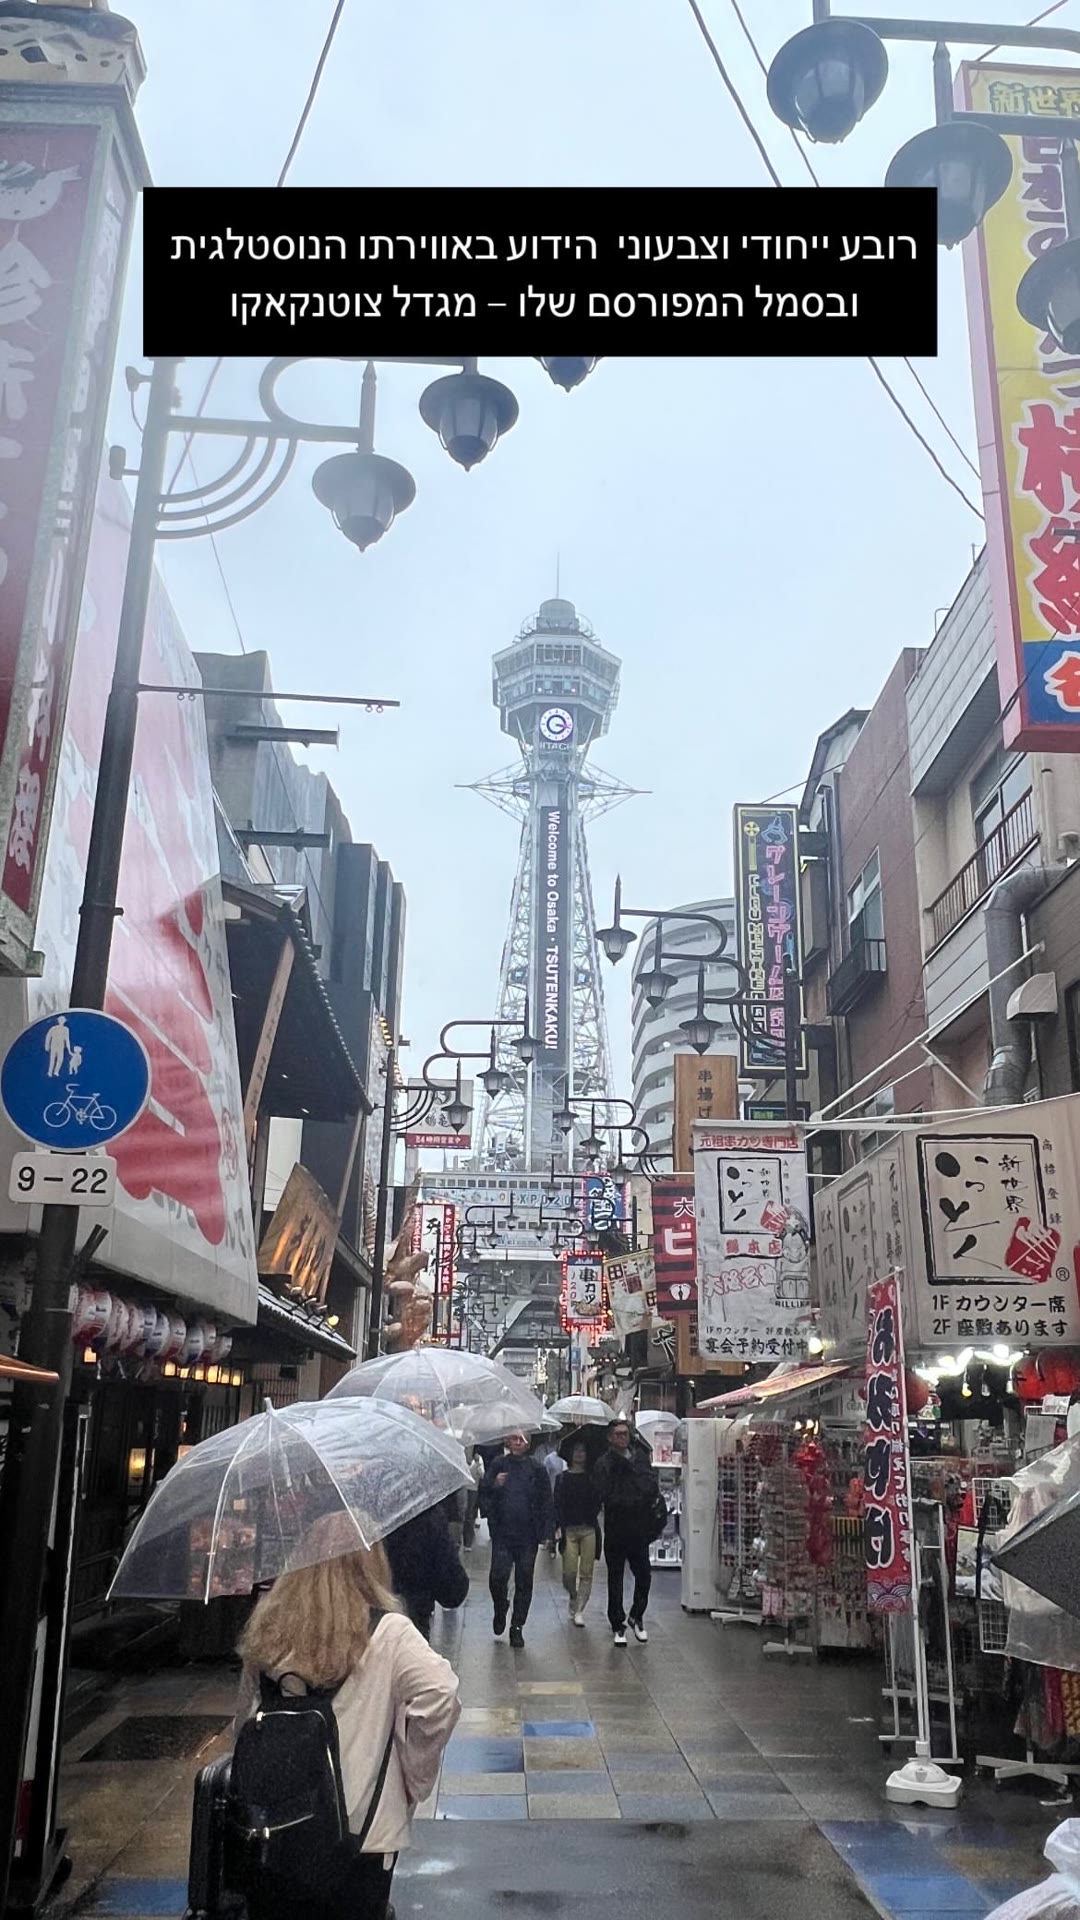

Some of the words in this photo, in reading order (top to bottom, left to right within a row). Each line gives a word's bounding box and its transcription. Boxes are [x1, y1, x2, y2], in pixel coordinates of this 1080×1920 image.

[547, 811, 560, 870] Welcome
[547, 874, 560, 887] to
[546, 888, 560, 933] Osaka
[544, 945, 559, 1050] TSUTENKAKU!
[998, 1154, 1028, 1214] 新世界
[932, 1295, 950, 1311] 1F
[955, 1295, 1066, 1313] カウンター席
[933, 1319, 951, 1335] 2F
[957, 1318, 1068, 1337] 座敷あります
[705, 1337, 809, 1356] 宴会予約受付中
